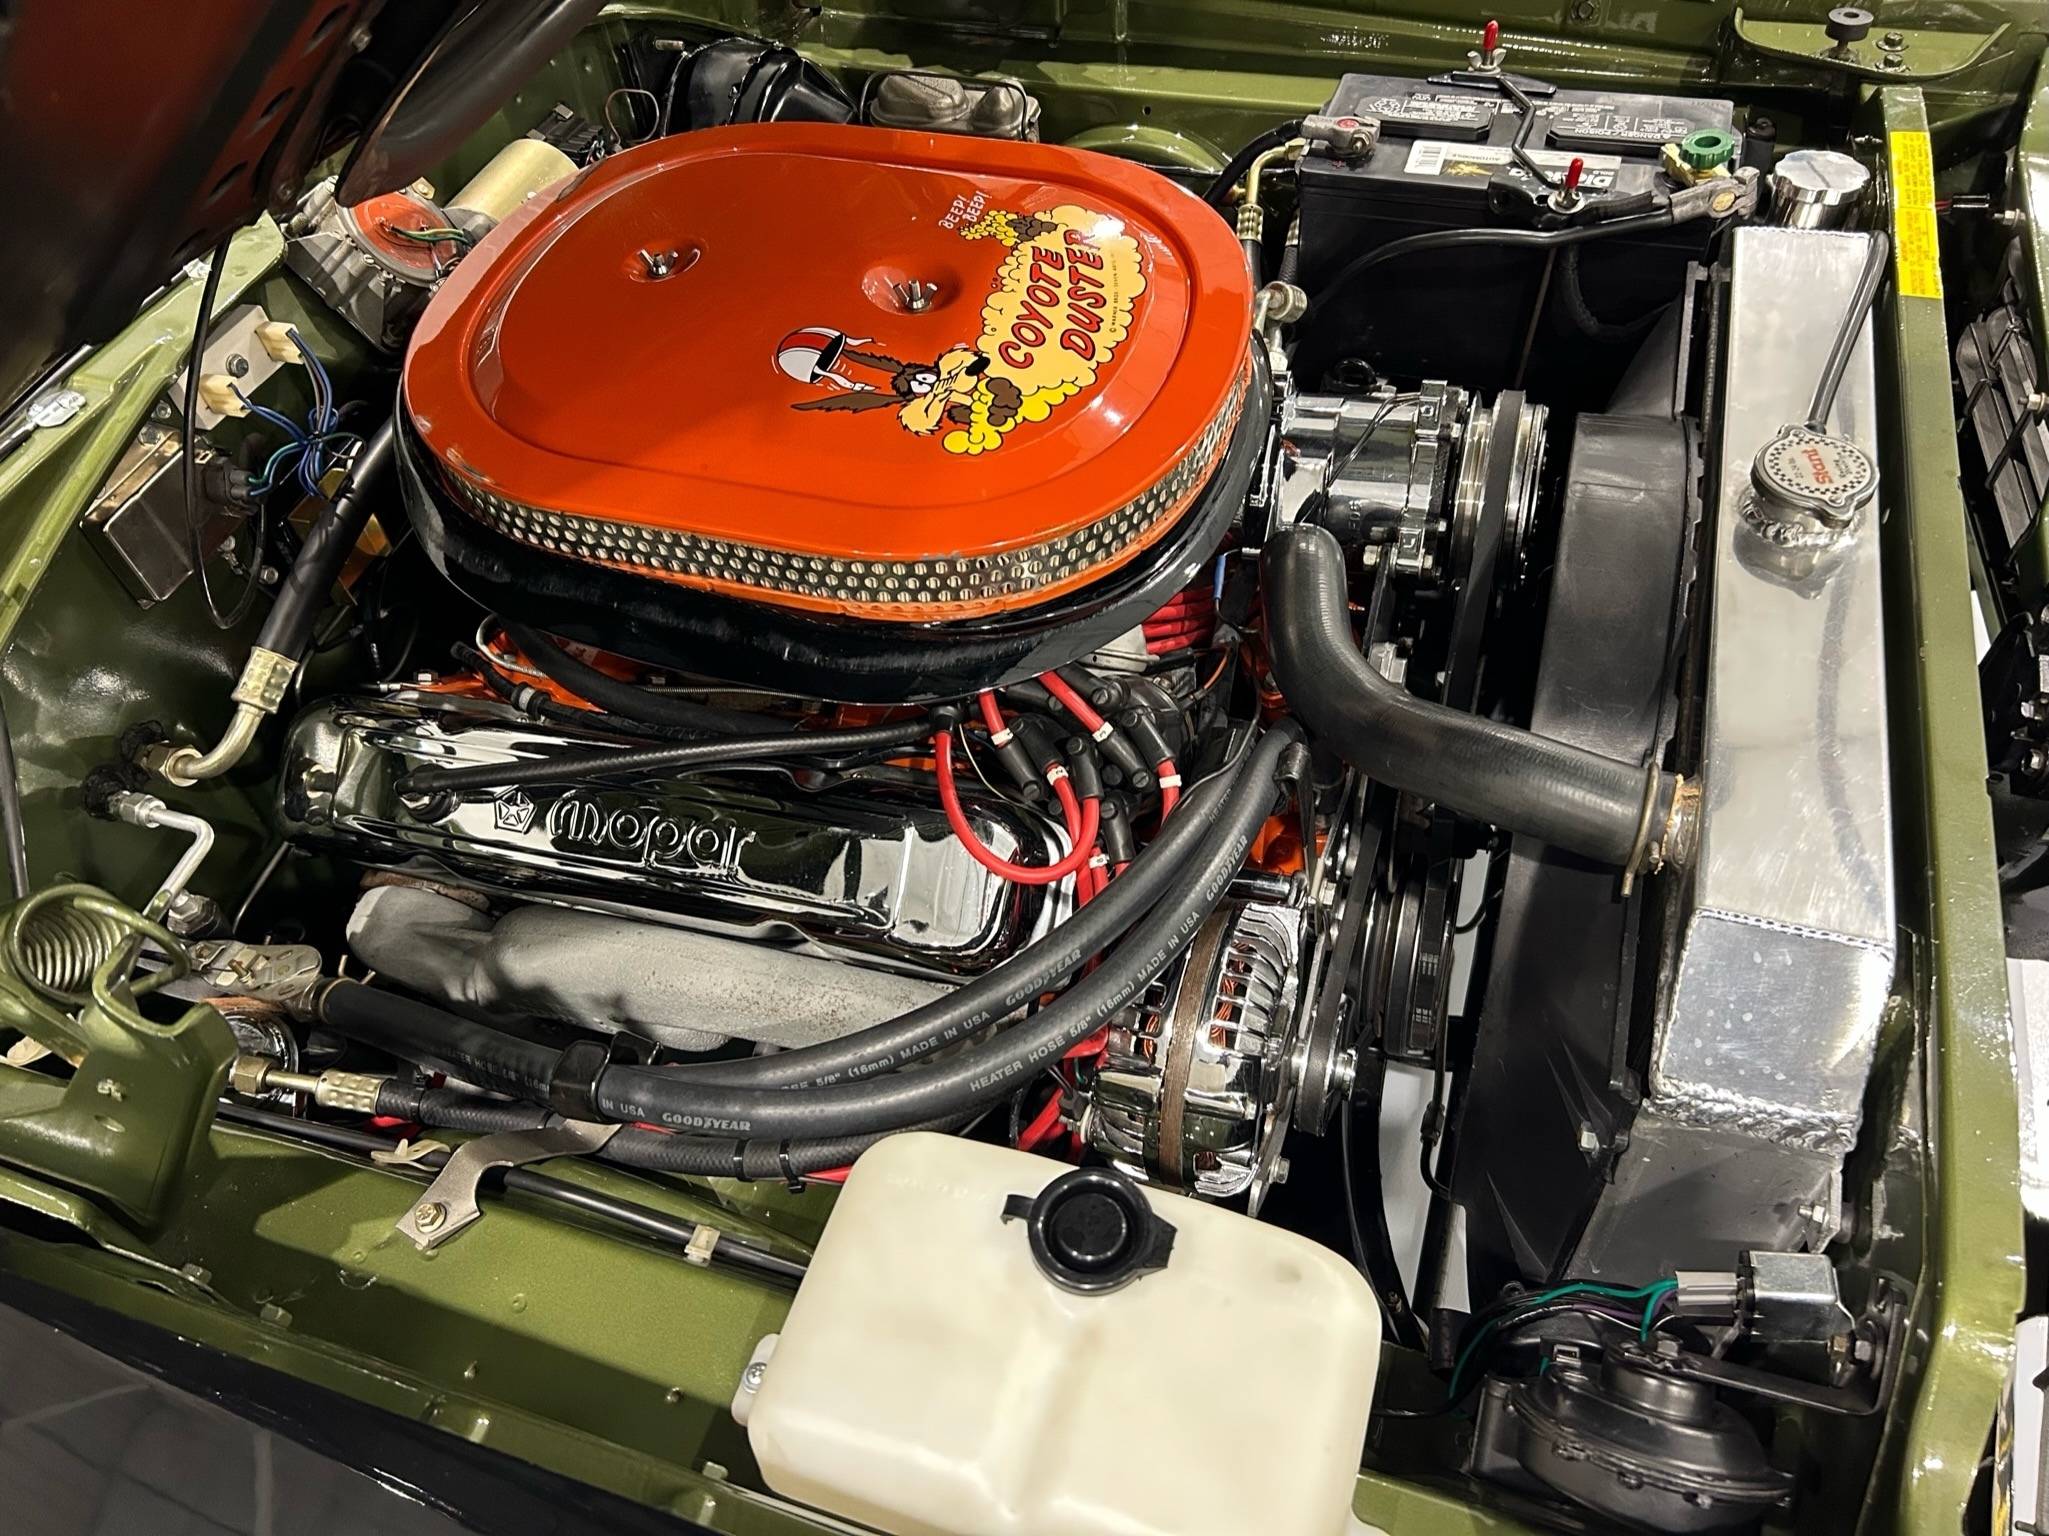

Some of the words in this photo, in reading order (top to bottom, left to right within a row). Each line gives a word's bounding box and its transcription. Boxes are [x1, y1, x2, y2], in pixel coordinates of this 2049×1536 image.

[938, 194, 970, 230] BEEP!
[962, 190, 993, 223] BEEP!
[999, 245, 1064, 369] COYOTE
[1060, 229, 1108, 361] DUSTER
[815, 1073, 842, 1088] 5/8"
[848, 1056, 895, 1079] (16mm)
[900, 1036, 939, 1059] MADE
[943, 1027, 958, 1041] IN
[963, 1010, 992, 1031] USA
[1004, 948, 1083, 1007] GOODYEAR
[969, 1060, 1024, 1093] HEATER
[1028, 1035, 1066, 1064] HOSE
[1069, 1015, 1093, 1040] 5/8"
[1096, 981, 1136, 1019] (16mm)
[1137, 949, 1166, 983] MADE
[1167, 933, 1181, 951] IN
[1179, 911, 1200, 934] USA
[1205, 834, 1249, 902] GOODYEAR
[601, 1097, 615, 1112] IN
[619, 1101, 646, 1119] USA
[661, 1111, 751, 1132] GOODYEAR
